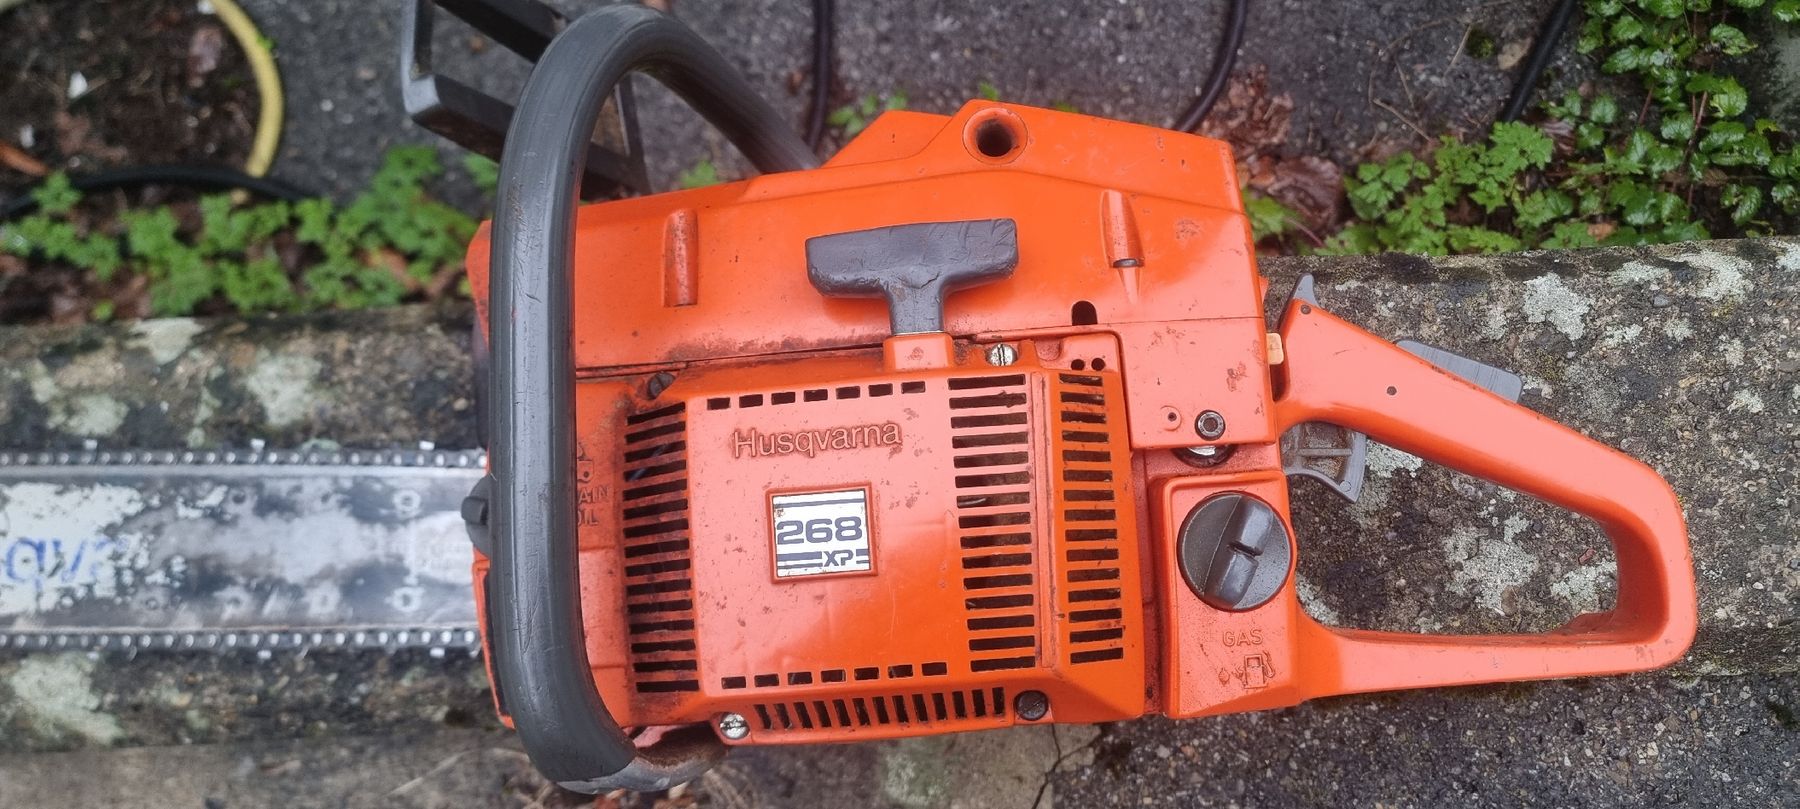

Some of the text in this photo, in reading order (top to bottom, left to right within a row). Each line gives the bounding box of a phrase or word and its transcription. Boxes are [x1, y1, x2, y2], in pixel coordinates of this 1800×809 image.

[733, 422, 902, 458] Husqvarna
[577, 485, 609, 504] AIN
[776, 516, 863, 545] 268
[823, 549, 854, 567] XP
[1222, 629, 1264, 647] GAS
